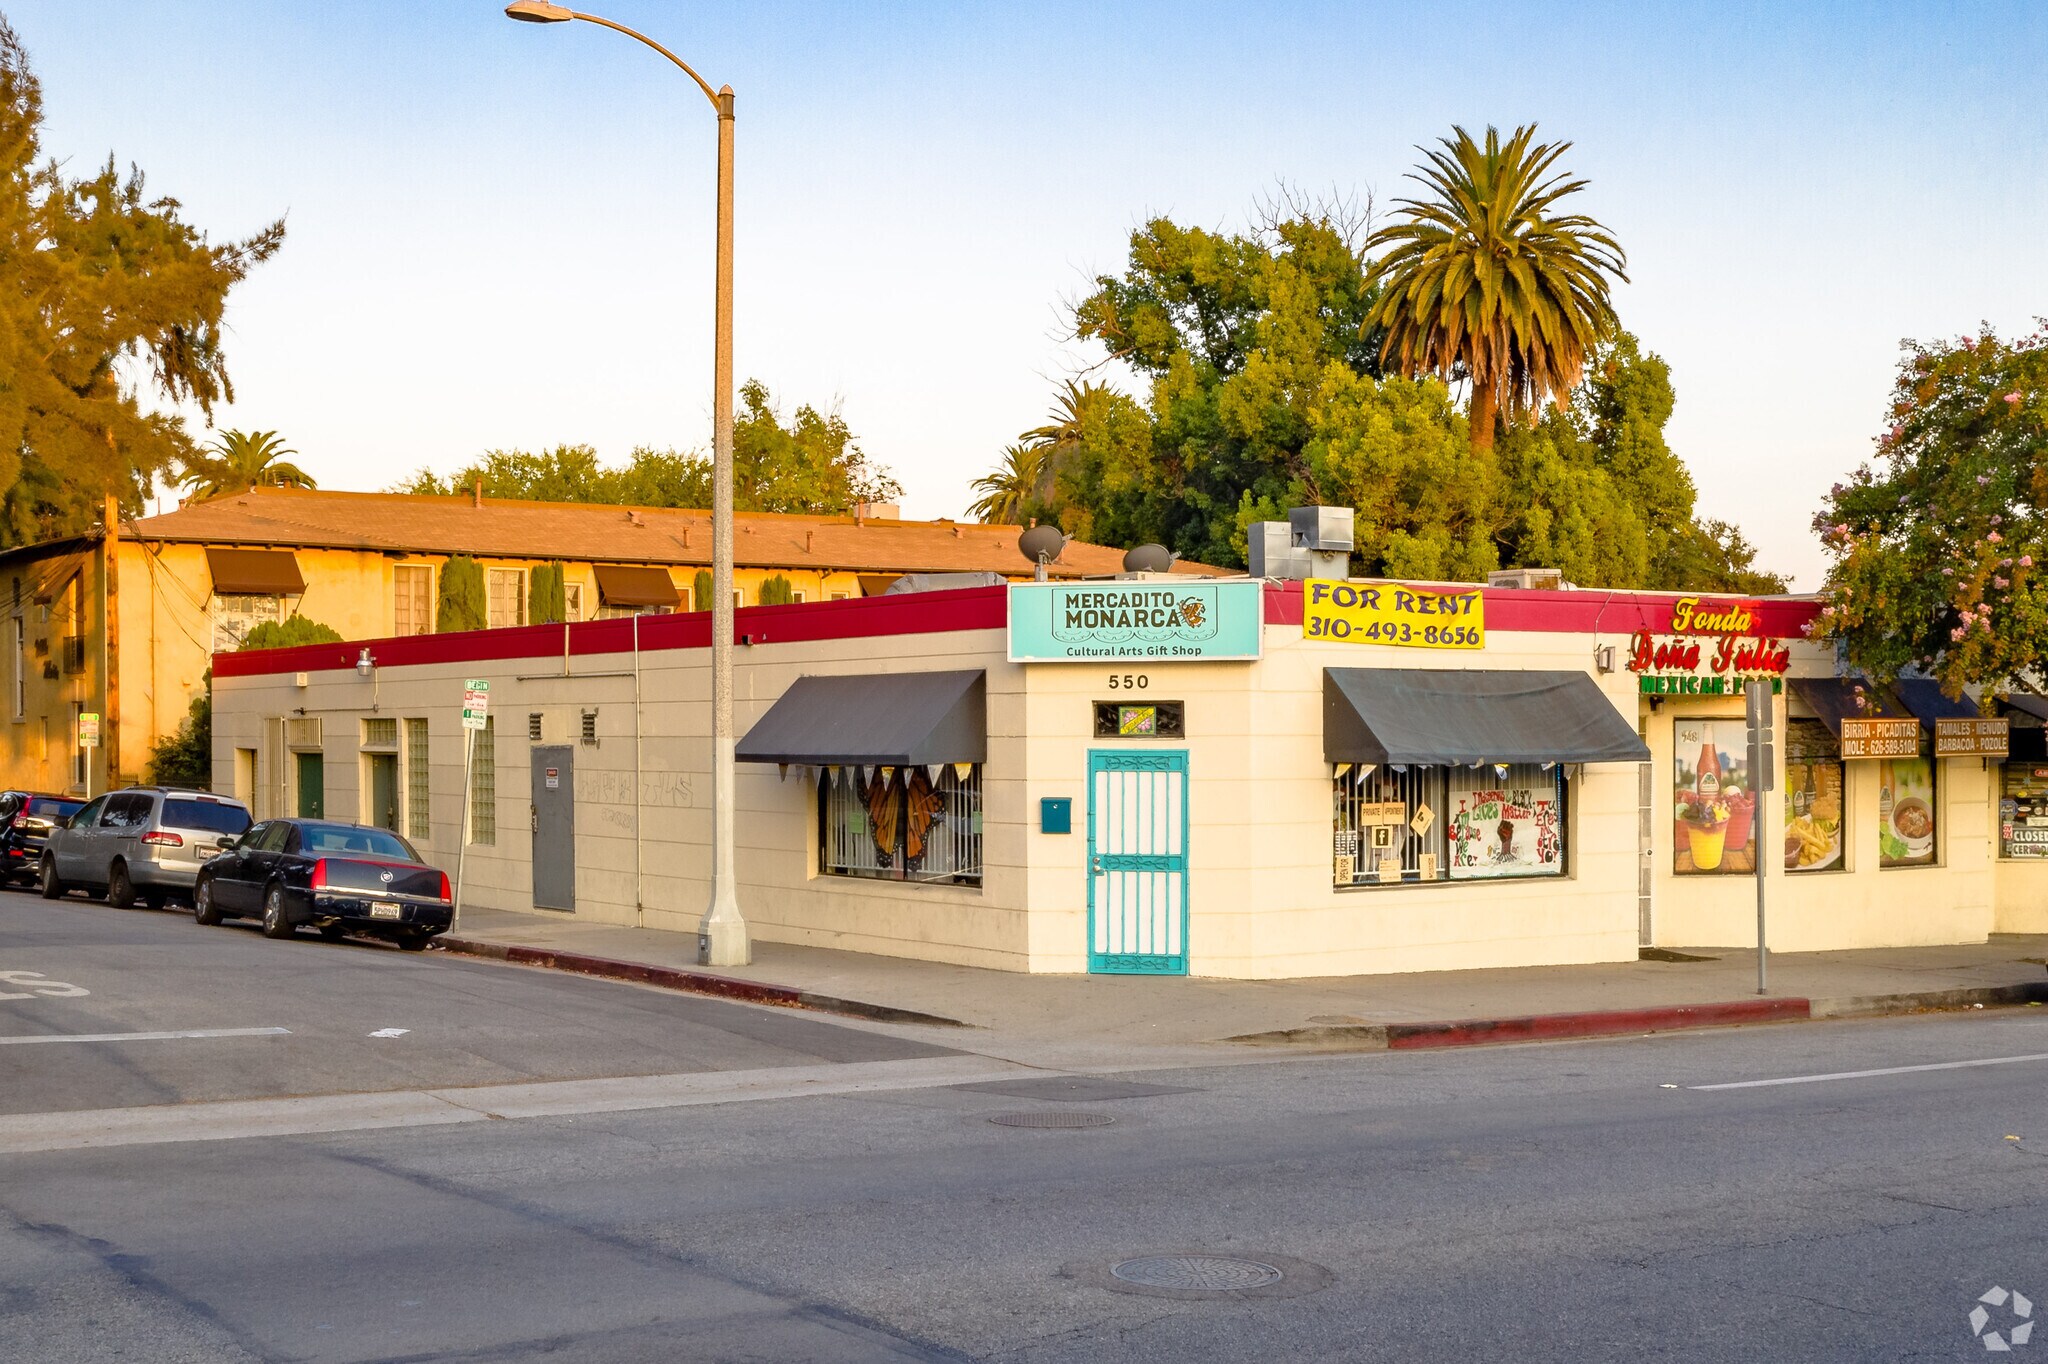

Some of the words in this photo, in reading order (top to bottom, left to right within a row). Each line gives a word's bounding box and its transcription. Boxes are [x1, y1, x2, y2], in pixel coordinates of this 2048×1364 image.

[1065, 591, 1175, 609] MERCADITO
[1311, 583, 1381, 611] FOR
[1394, 590, 1478, 615] RENT
[1065, 609, 1182, 629] MONARCA
[1672, 597, 1752, 632] Fonda
[1308, 616, 1480, 645] 310-493-8656
[1066, 646, 1116, 657] Cultural
[1119, 646, 1143, 656] Arts
[1146, 645, 1168, 656] Gift
[1172, 645, 1202, 657] Shop
[1628, 629, 1700, 672] Doña
[1710, 632, 1790, 675] Julia
[467, 681, 488, 690] BEGIN
[1108, 674, 1149, 689] 550
[1639, 675, 1725, 694] MEXICAN
[1844, 723, 1871, 738] BIRRIA
[1876, 723, 1917, 738] PICADITAS
[1937, 722, 1971, 736] TAMALES
[1976, 722, 2008, 735] MENUDO
[1844, 740, 1865, 755] MOLE
[1870, 739, 1916, 755] 626-589-5104
[1938, 738, 1975, 751] BARBACOA
[1980, 737, 2007, 750] POZOLE
[1363, 807, 1381, 816] PRIVATE
[1459, 800, 1467, 813] I
[1340, 858, 1349, 868] FOR
[1339, 868, 1348, 881] OPEN
